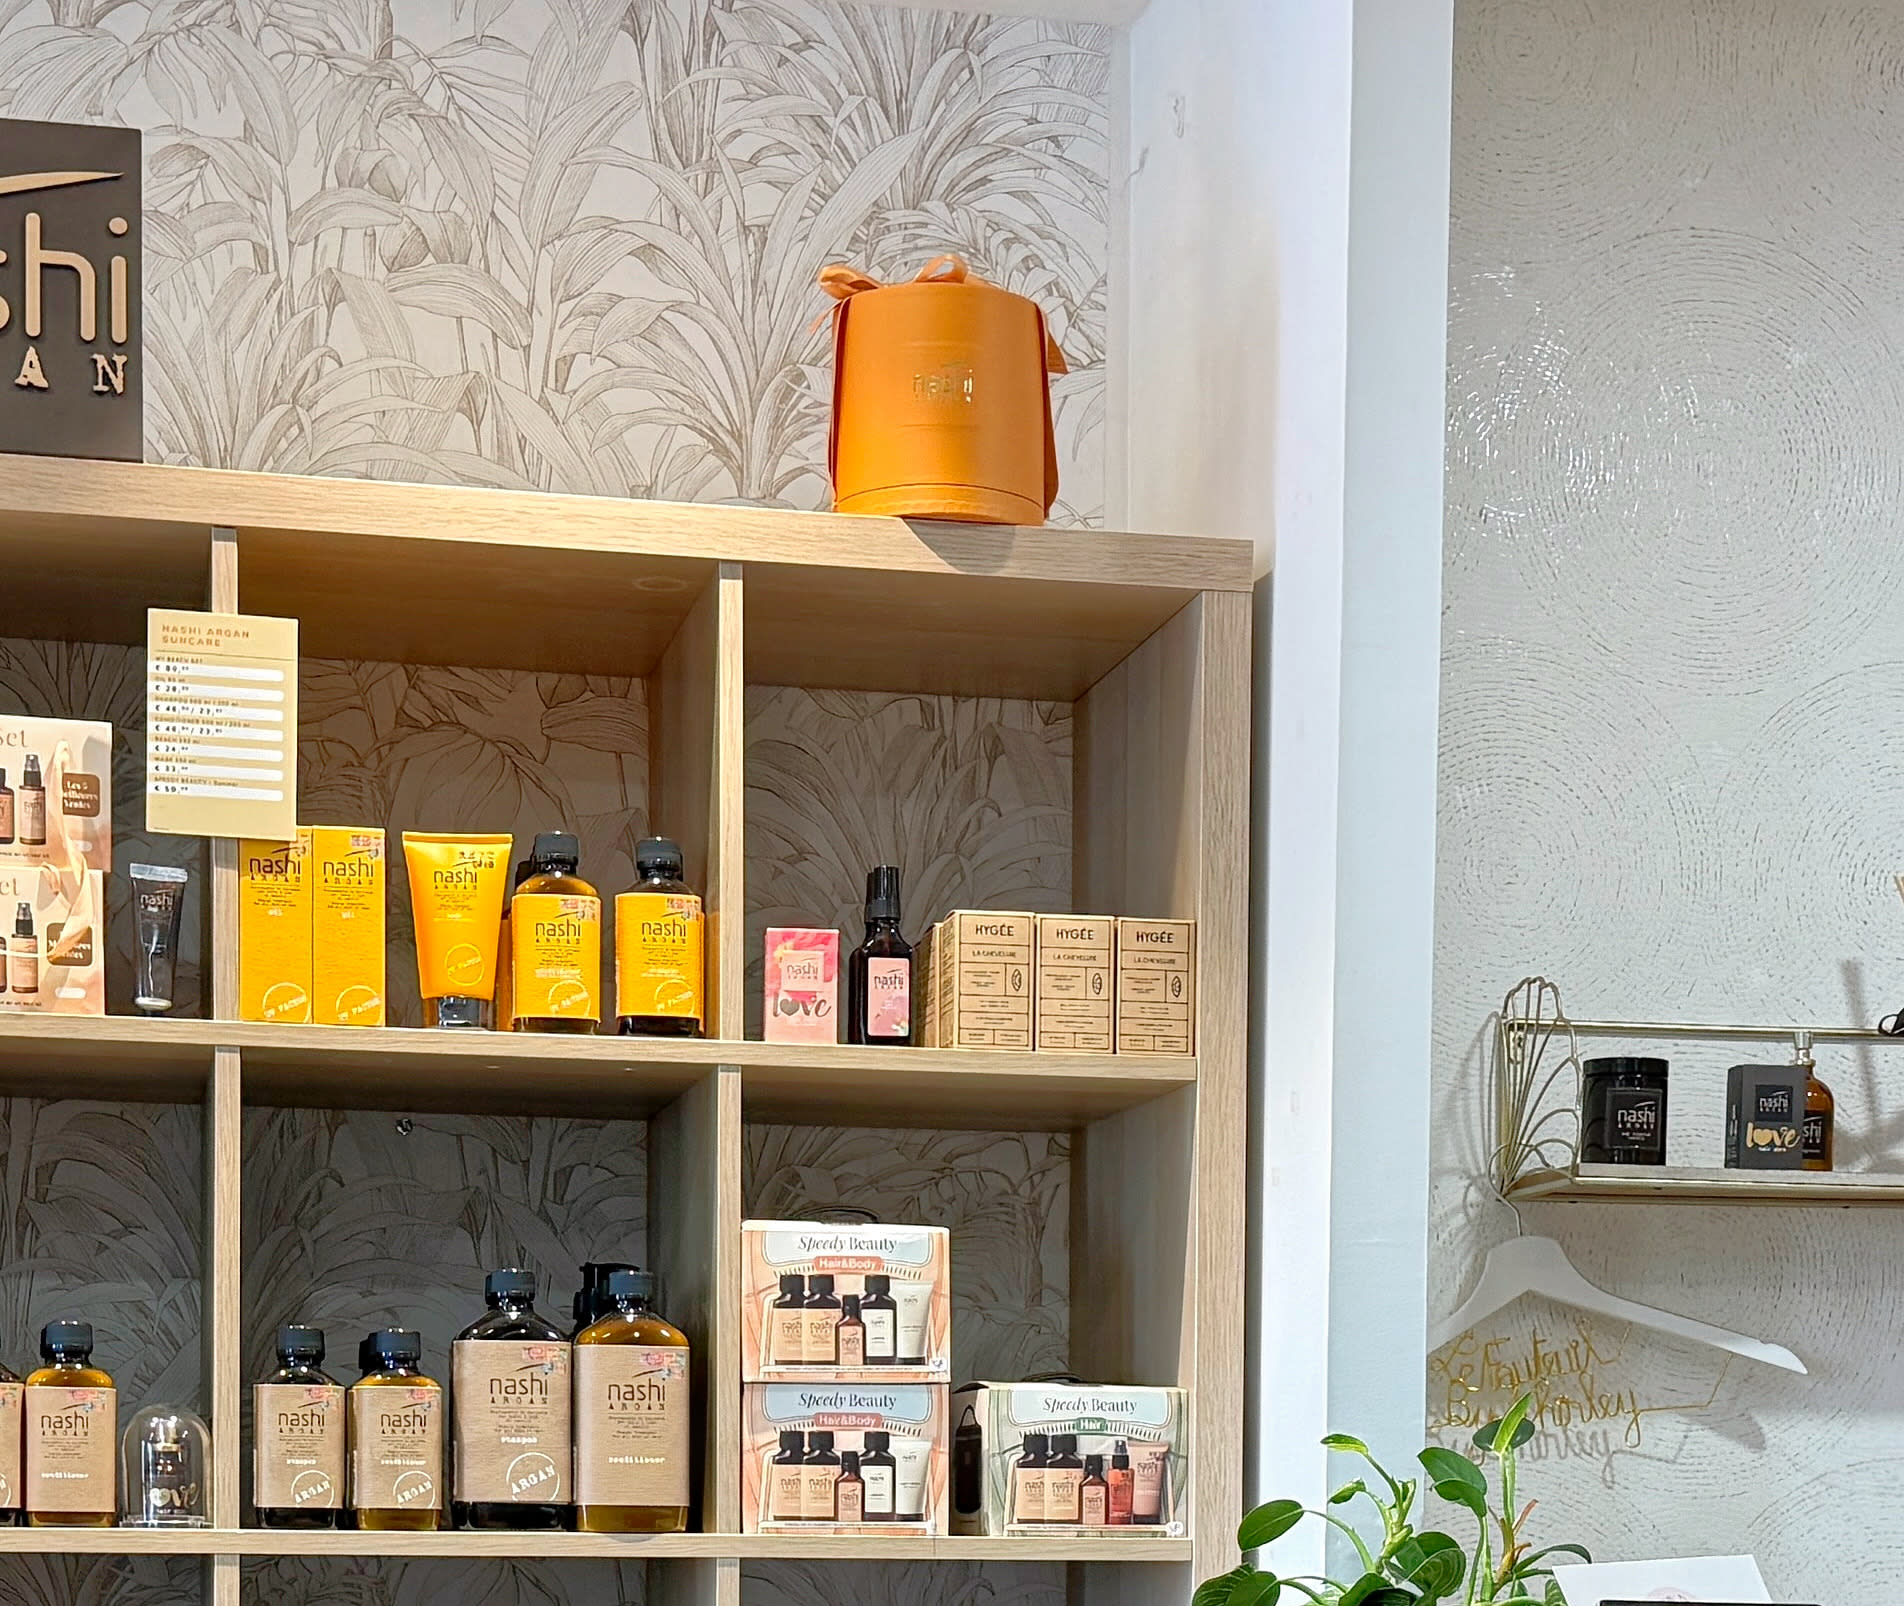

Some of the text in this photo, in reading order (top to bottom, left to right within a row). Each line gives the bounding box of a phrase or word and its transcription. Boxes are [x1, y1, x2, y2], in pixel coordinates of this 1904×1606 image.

[162, 625, 249, 638] NASHI ARGAN
[162, 636, 221, 647] SUNCARE
[249, 855, 301, 875] nashi
[323, 857, 374, 877] nashi
[434, 867, 478, 883] nashi
[535, 918, 581, 937] nashi
[641, 919, 687, 937] nashi
[975, 924, 1014, 937] HYGÉE
[1056, 928, 1095, 940] HYGÉE
[1136, 931, 1174, 943] HYGÉE
[786, 962, 818, 976] nashi
[873, 969, 904, 986] nashi
[1759, 1095, 1789, 1108] nashi
[1617, 1106, 1656, 1123] nashi
[1746, 1121, 1801, 1148] love
[798, 1236, 897, 1253] Speedy Beauty
[819, 1258, 876, 1270] Hair&Body
[490, 1372, 548, 1395] nashi
[608, 1377, 666, 1401] nashi
[798, 1392, 897, 1410] Speedy Beauty
[1043, 1397, 1137, 1415] Speedy Beauty
[41, 1410, 89, 1429] nashi
[278, 1409, 324, 1428] nashi
[381, 1409, 427, 1428] nashi
[819, 1414, 876, 1426] Hair&Body
[511, 1464, 556, 1495] ARGAN
[295, 1480, 331, 1504] ARGAN
[397, 1480, 433, 1504] ARGAN
